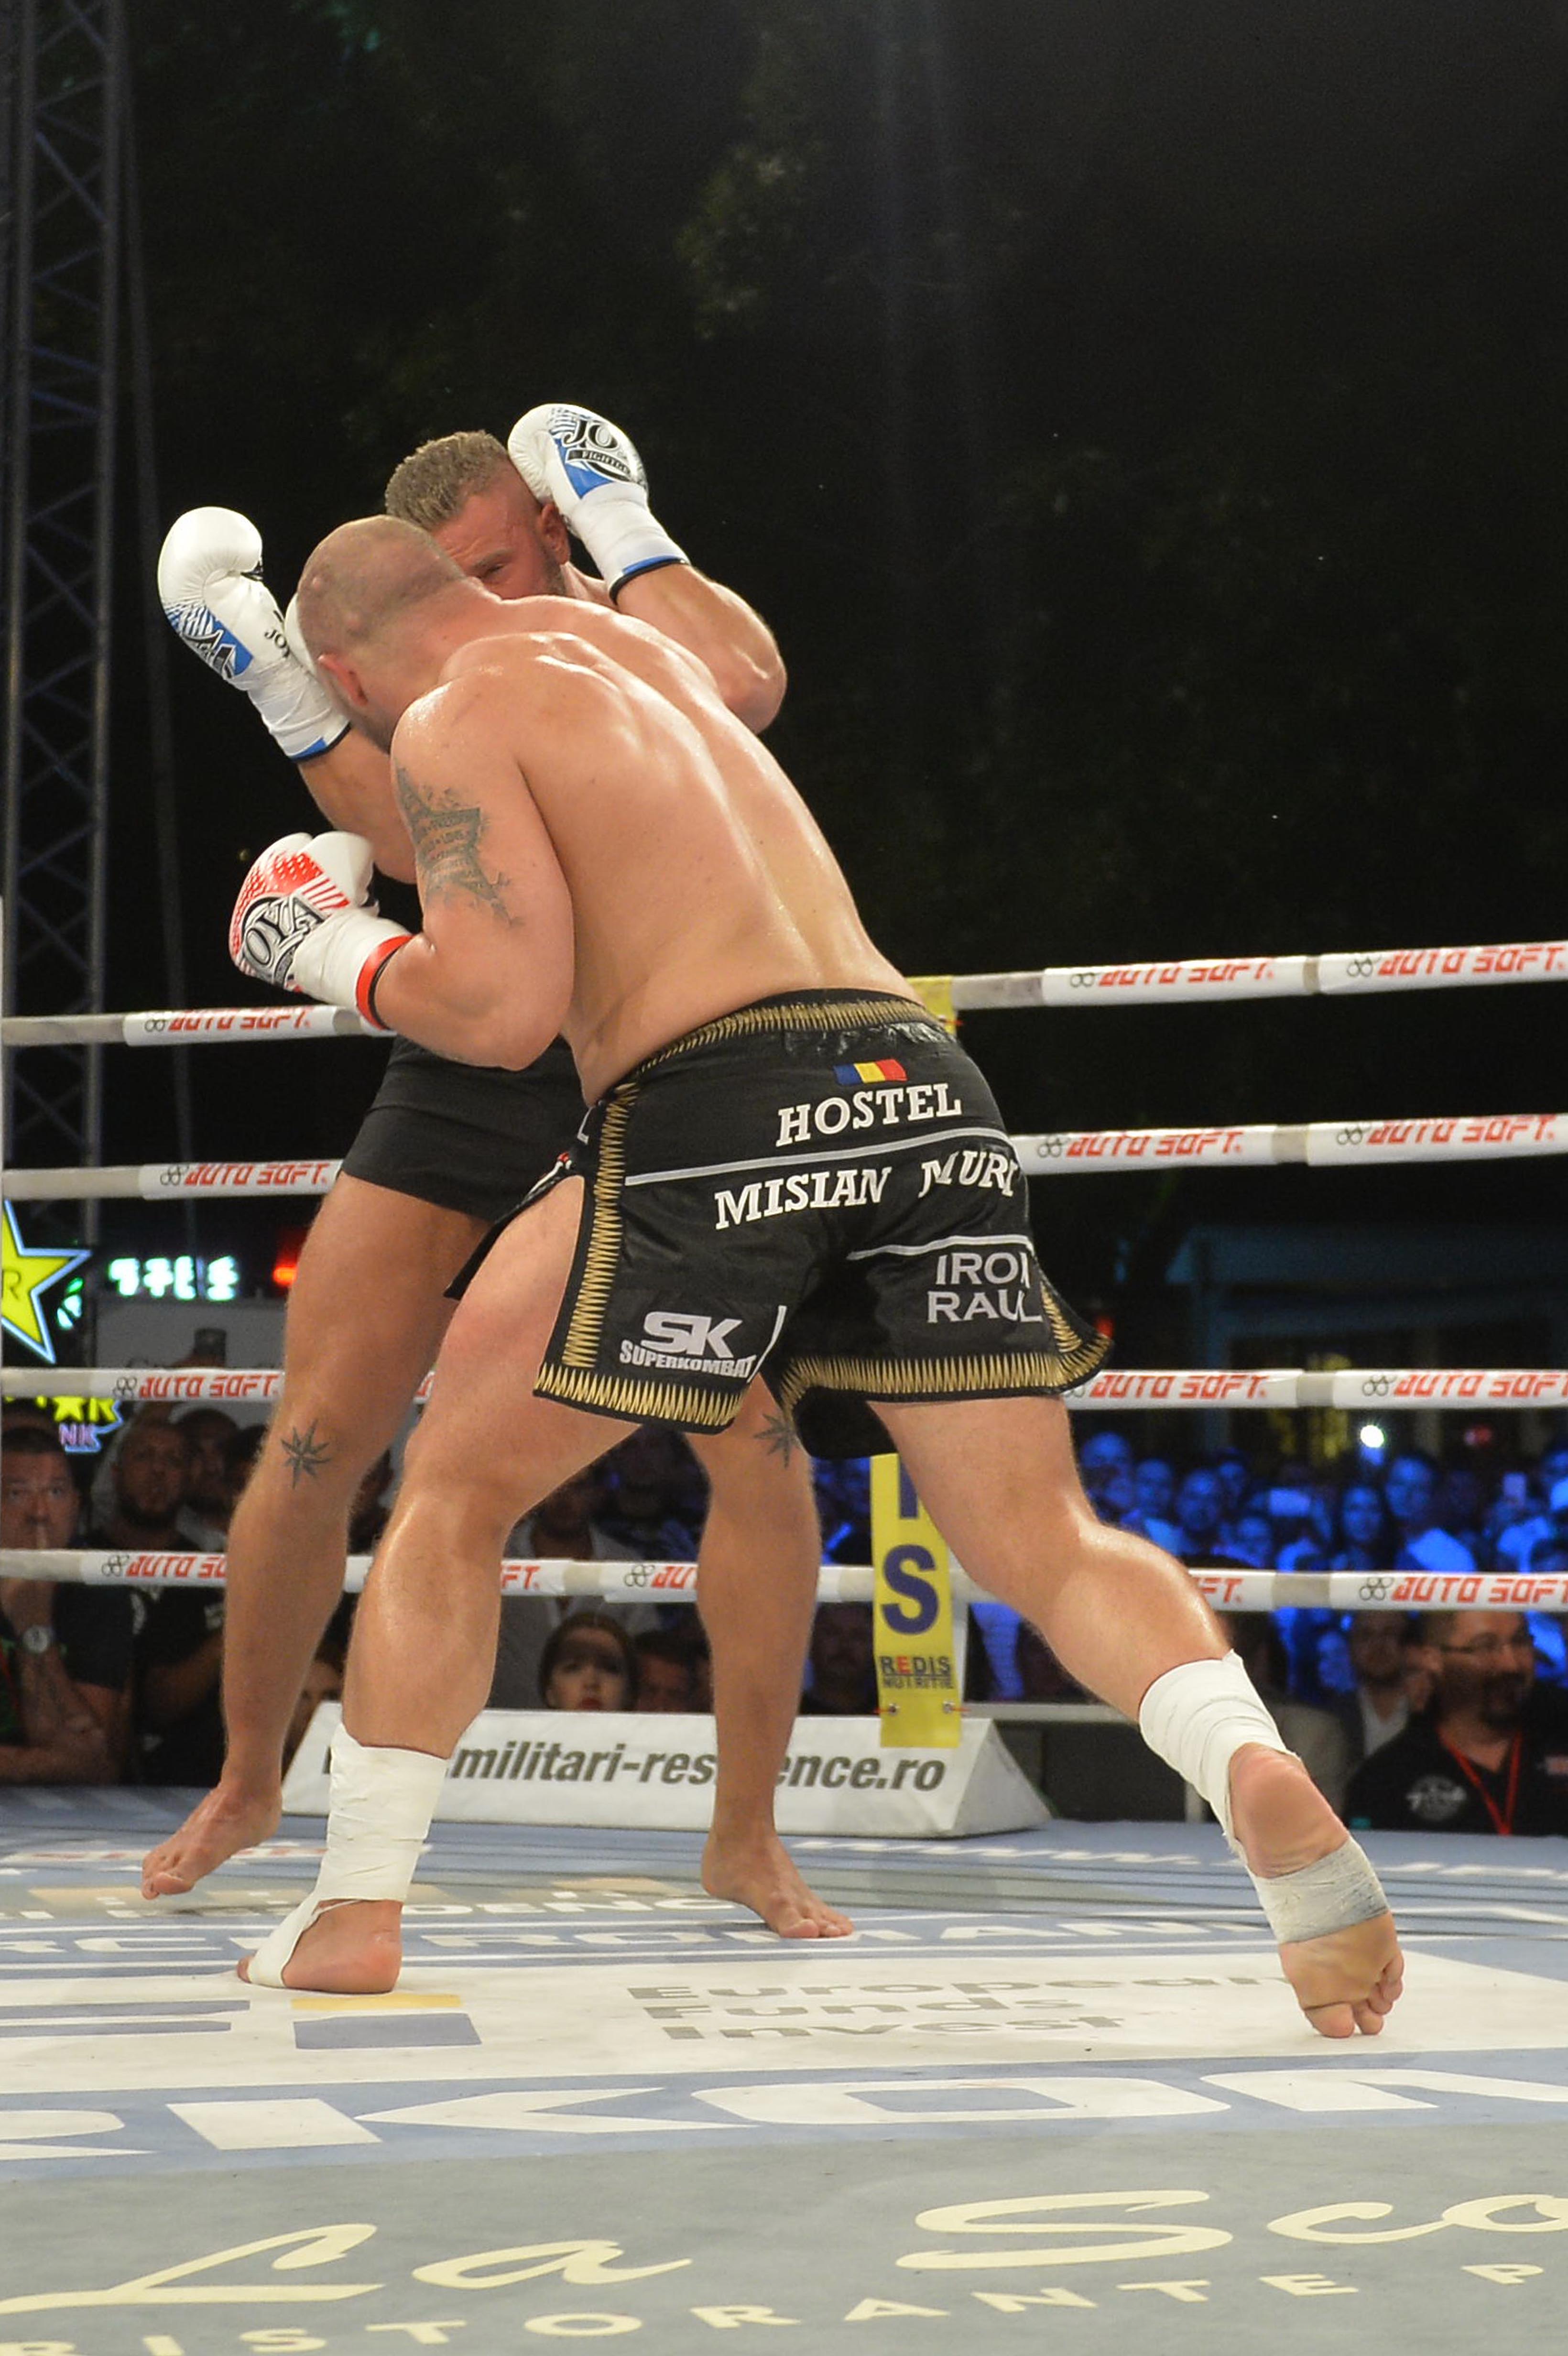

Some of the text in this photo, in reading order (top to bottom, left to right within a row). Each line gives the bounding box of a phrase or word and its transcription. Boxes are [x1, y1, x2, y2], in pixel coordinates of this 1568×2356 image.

[775, 1083, 962, 1147] HOSTEL
[714, 1166, 893, 1230] MISIAN
[926, 1289, 1044, 1324] RAUL
[640, 1311, 743, 1359] SK
[619, 1340, 757, 1379] SUPERKOMBAT
[198, 1556, 227, 1579] SO
[880, 1656, 951, 1675] REDIS
[642, 1996, 1085, 2019] Funds
[660, 2015, 1125, 2040] Invest
